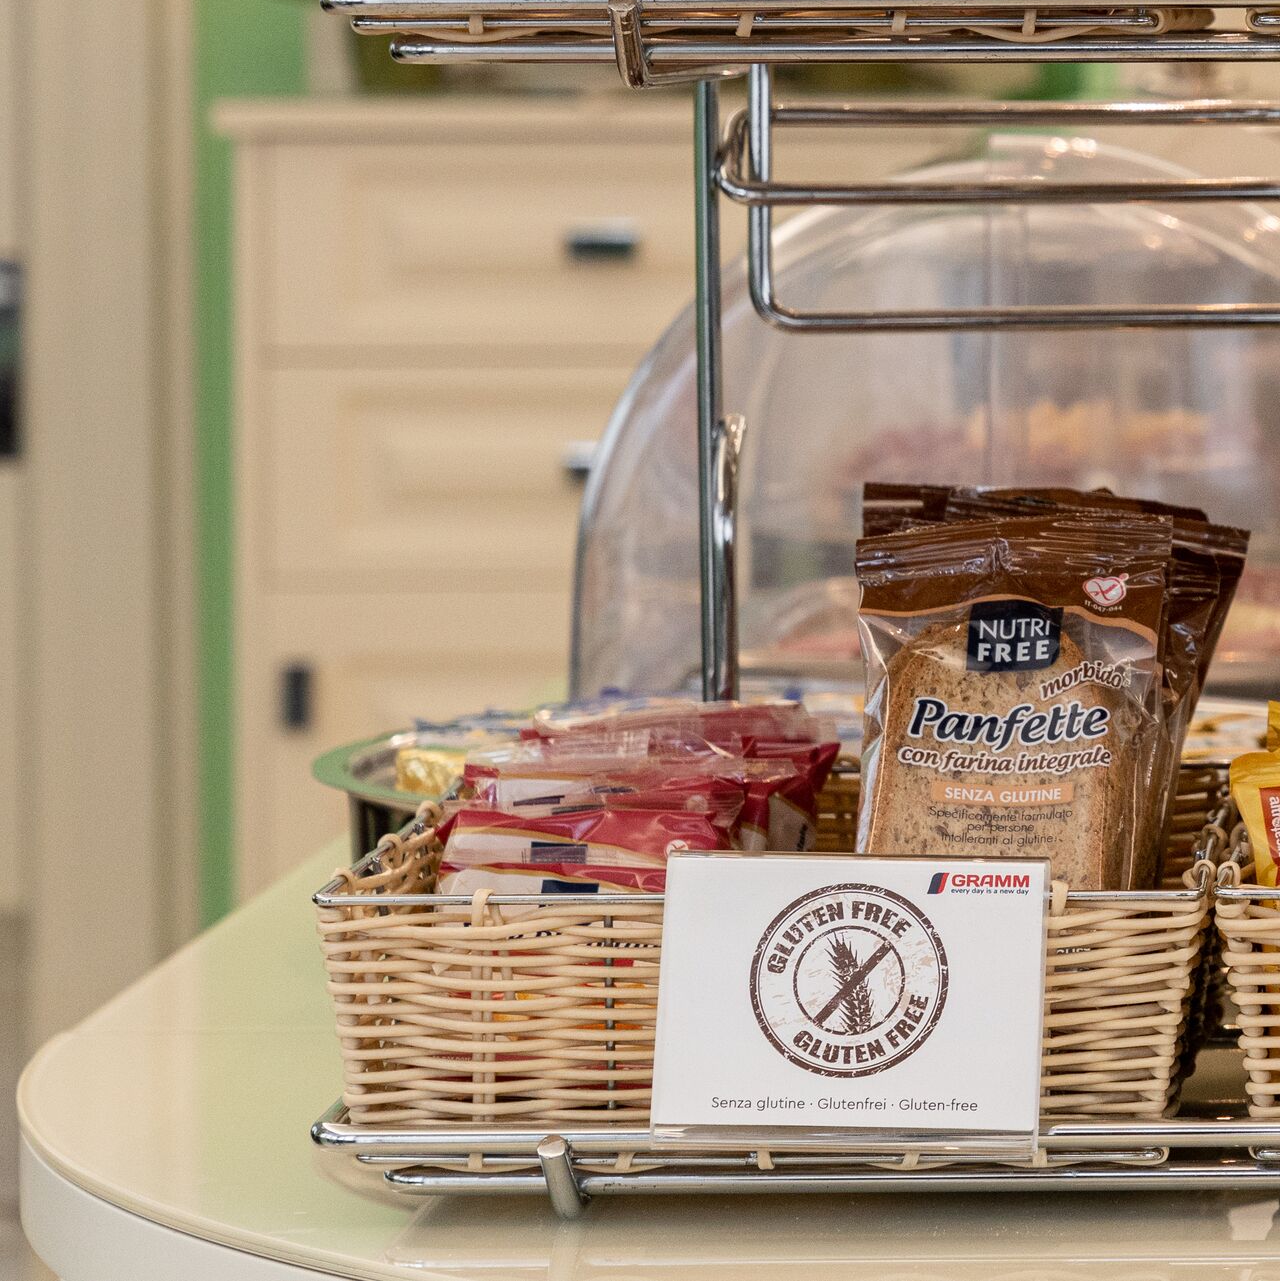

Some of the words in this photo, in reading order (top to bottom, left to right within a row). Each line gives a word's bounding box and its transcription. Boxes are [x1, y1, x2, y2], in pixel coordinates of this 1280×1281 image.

[979, 618, 1050, 640] NUTRI
[977, 639, 1050, 662] FREE
[1040, 661, 1122, 701] morbido
[911, 699, 1110, 750] Panfette
[900, 748, 939, 766] con
[942, 751, 1014, 771] farina
[1017, 748, 1111, 773] integrale
[944, 786, 995, 803] SENZA
[1000, 788, 1062, 804] GLUTINE
[929, 806, 1017, 821] Specificamente
[1021, 808, 1073, 821] formulato
[967, 822, 986, 833] per
[990, 822, 1034, 833] persone
[1002, 836, 1013, 845] al
[951, 874, 1029, 887] GRAMM
[1016, 888, 1029, 896] day
[766, 901, 845, 975] GLUTEN
[851, 900, 914, 939] FREE
[792, 1029, 887, 1065] GLUTEN
[889, 994, 930, 1048] FREE
[711, 1096, 752, 1110] Senza
[756, 1096, 805, 1111] glutine
[817, 1096, 887, 1111] Glutenfrei
[899, 1098, 978, 1113] Gluten-free
